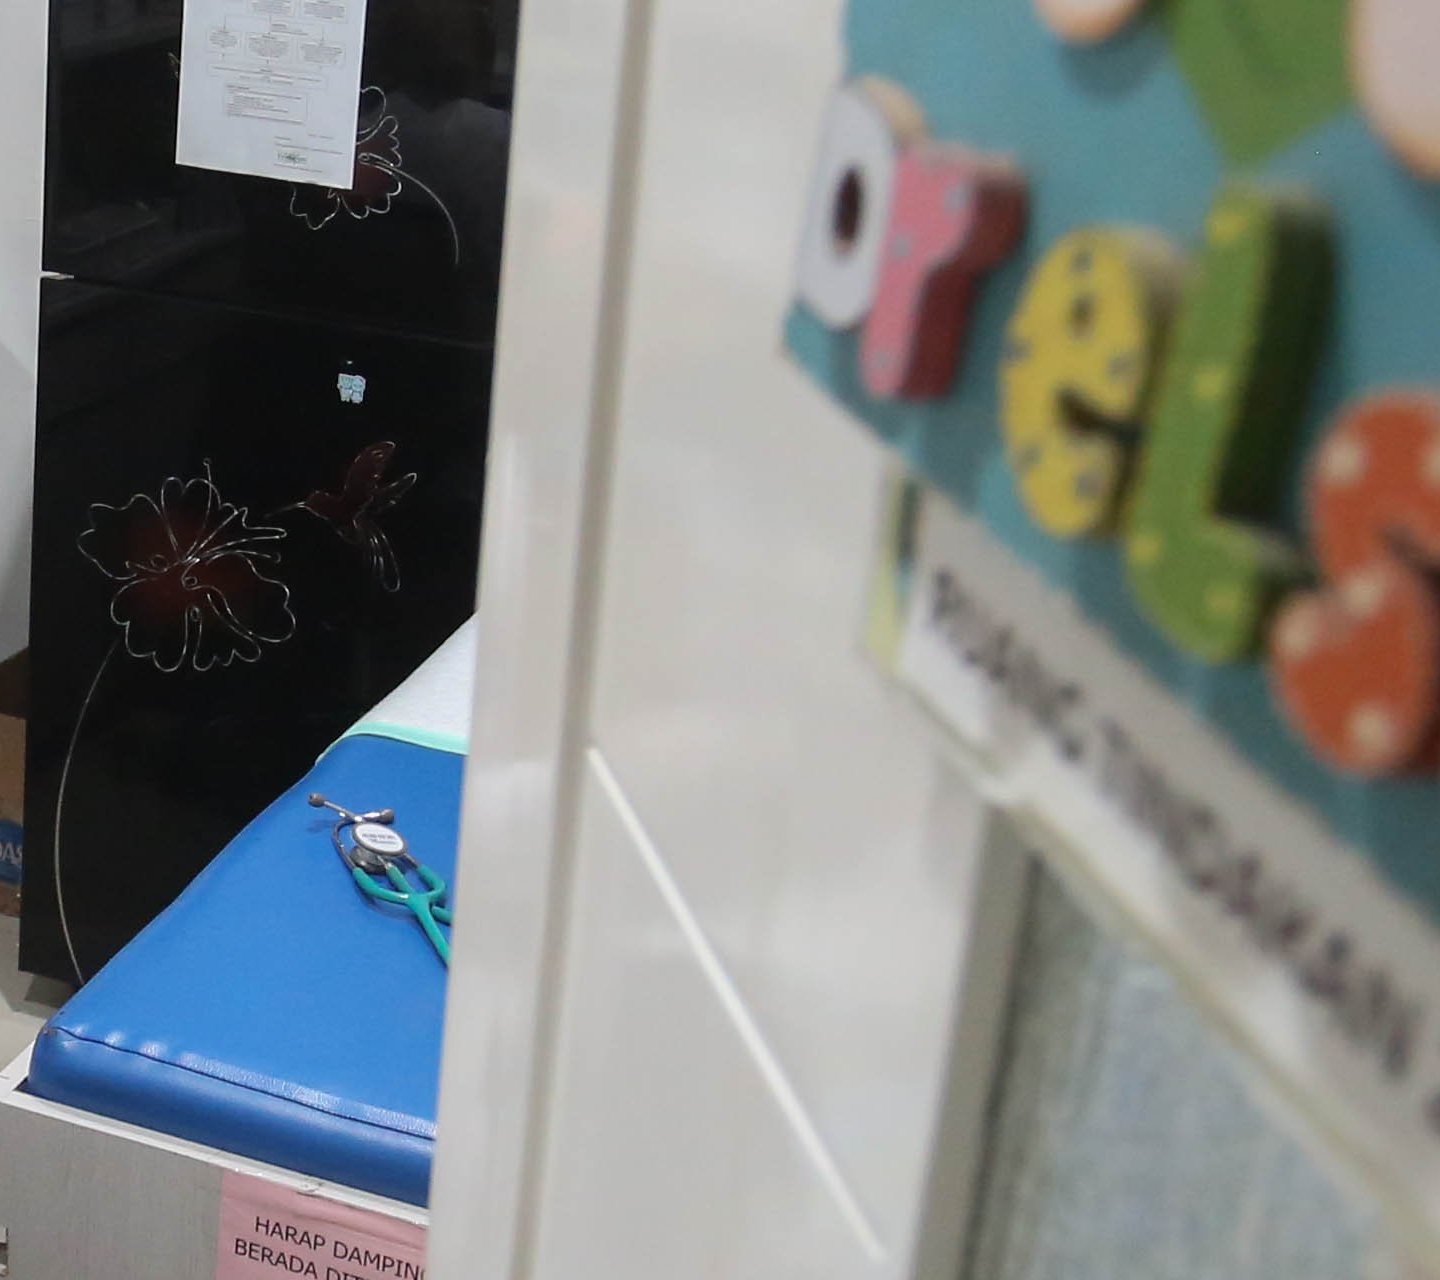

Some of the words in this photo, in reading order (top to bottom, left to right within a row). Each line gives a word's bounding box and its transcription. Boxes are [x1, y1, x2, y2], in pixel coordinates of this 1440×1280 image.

[1097, 720, 1418, 1082] TINDAKAN
[255, 1215, 326, 1251] HARAP
[234, 1238, 319, 1279] BERADA
